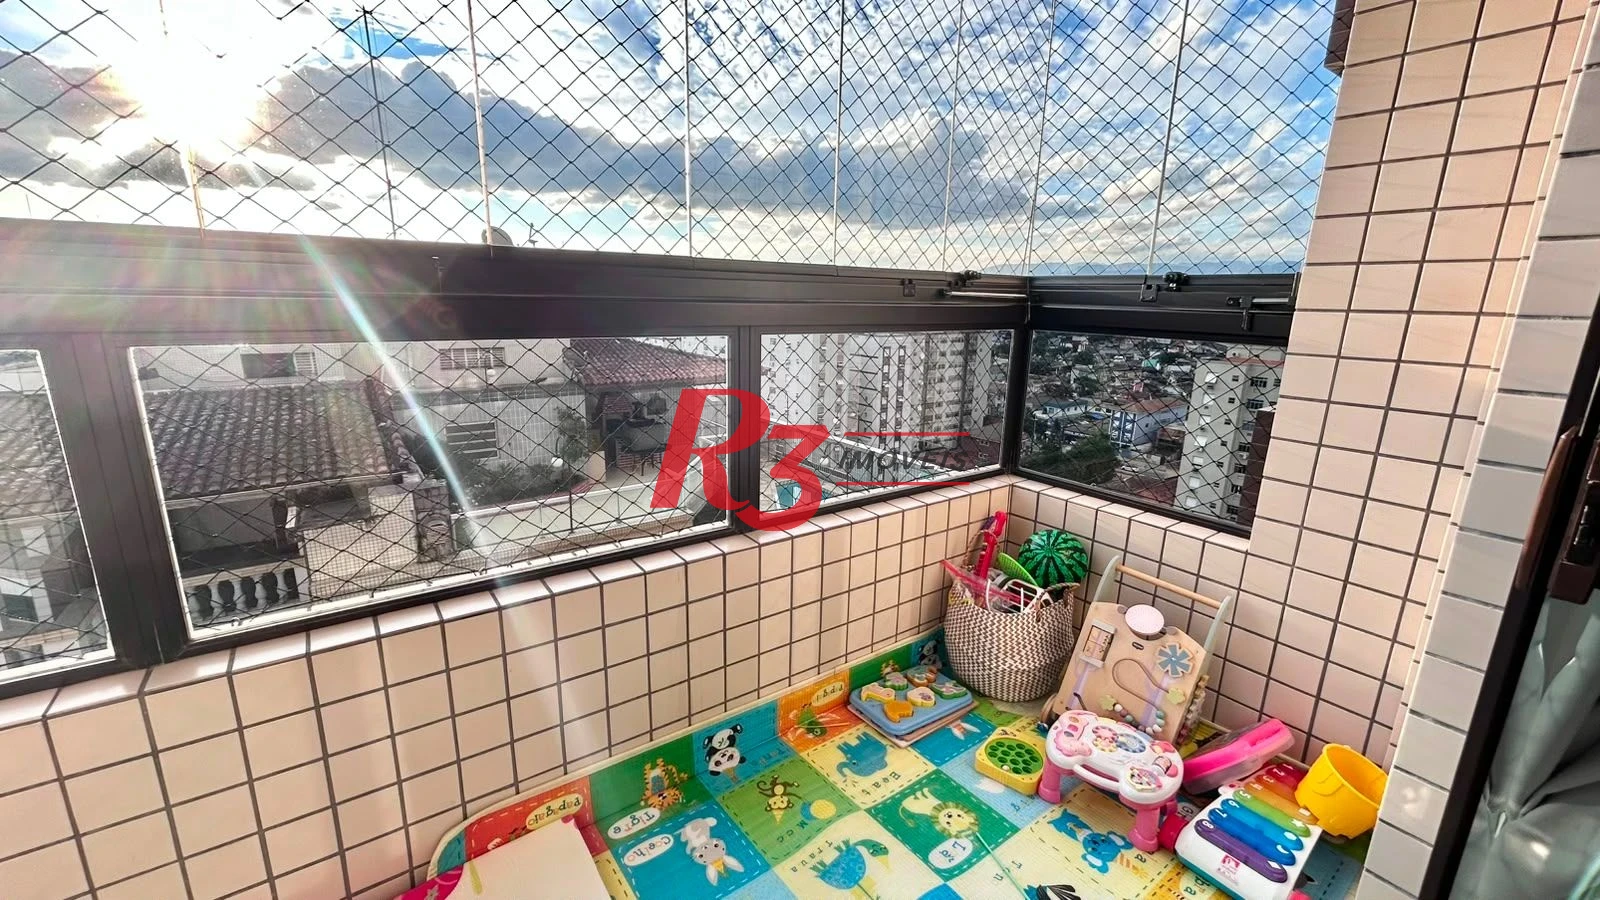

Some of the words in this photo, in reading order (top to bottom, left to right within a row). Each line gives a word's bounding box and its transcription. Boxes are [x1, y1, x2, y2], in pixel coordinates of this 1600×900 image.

[1239, 790, 1251, 798] 5
[527, 797, 581, 827] Papagaio
[612, 810, 655, 835] Tigre
[1202, 820, 1214, 829] 8
[625, 835, 671, 864] Coelho
